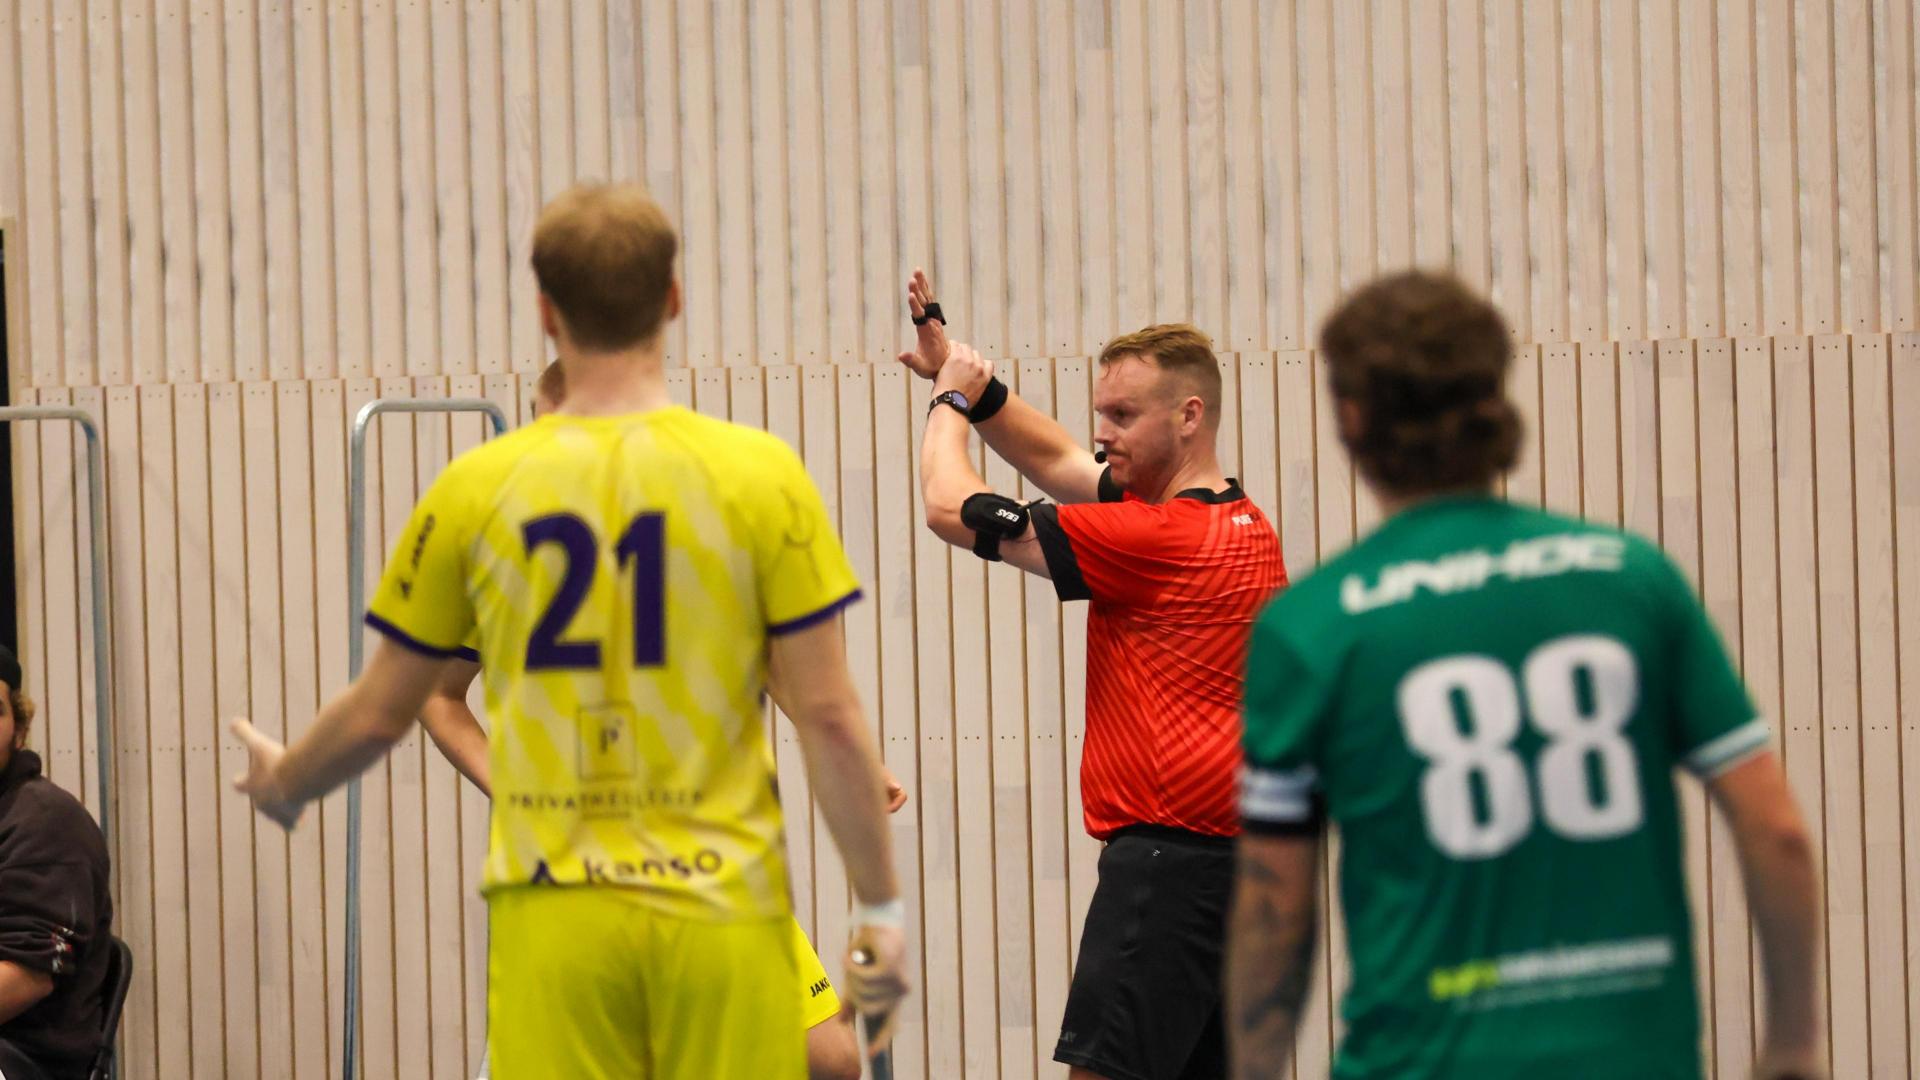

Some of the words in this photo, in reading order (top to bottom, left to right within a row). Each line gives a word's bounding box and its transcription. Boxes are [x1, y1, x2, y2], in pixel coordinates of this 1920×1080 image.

[521, 510, 667, 671] 21
[1340, 533, 1626, 615] UNIHOC
[1396, 633, 1643, 860] 88
